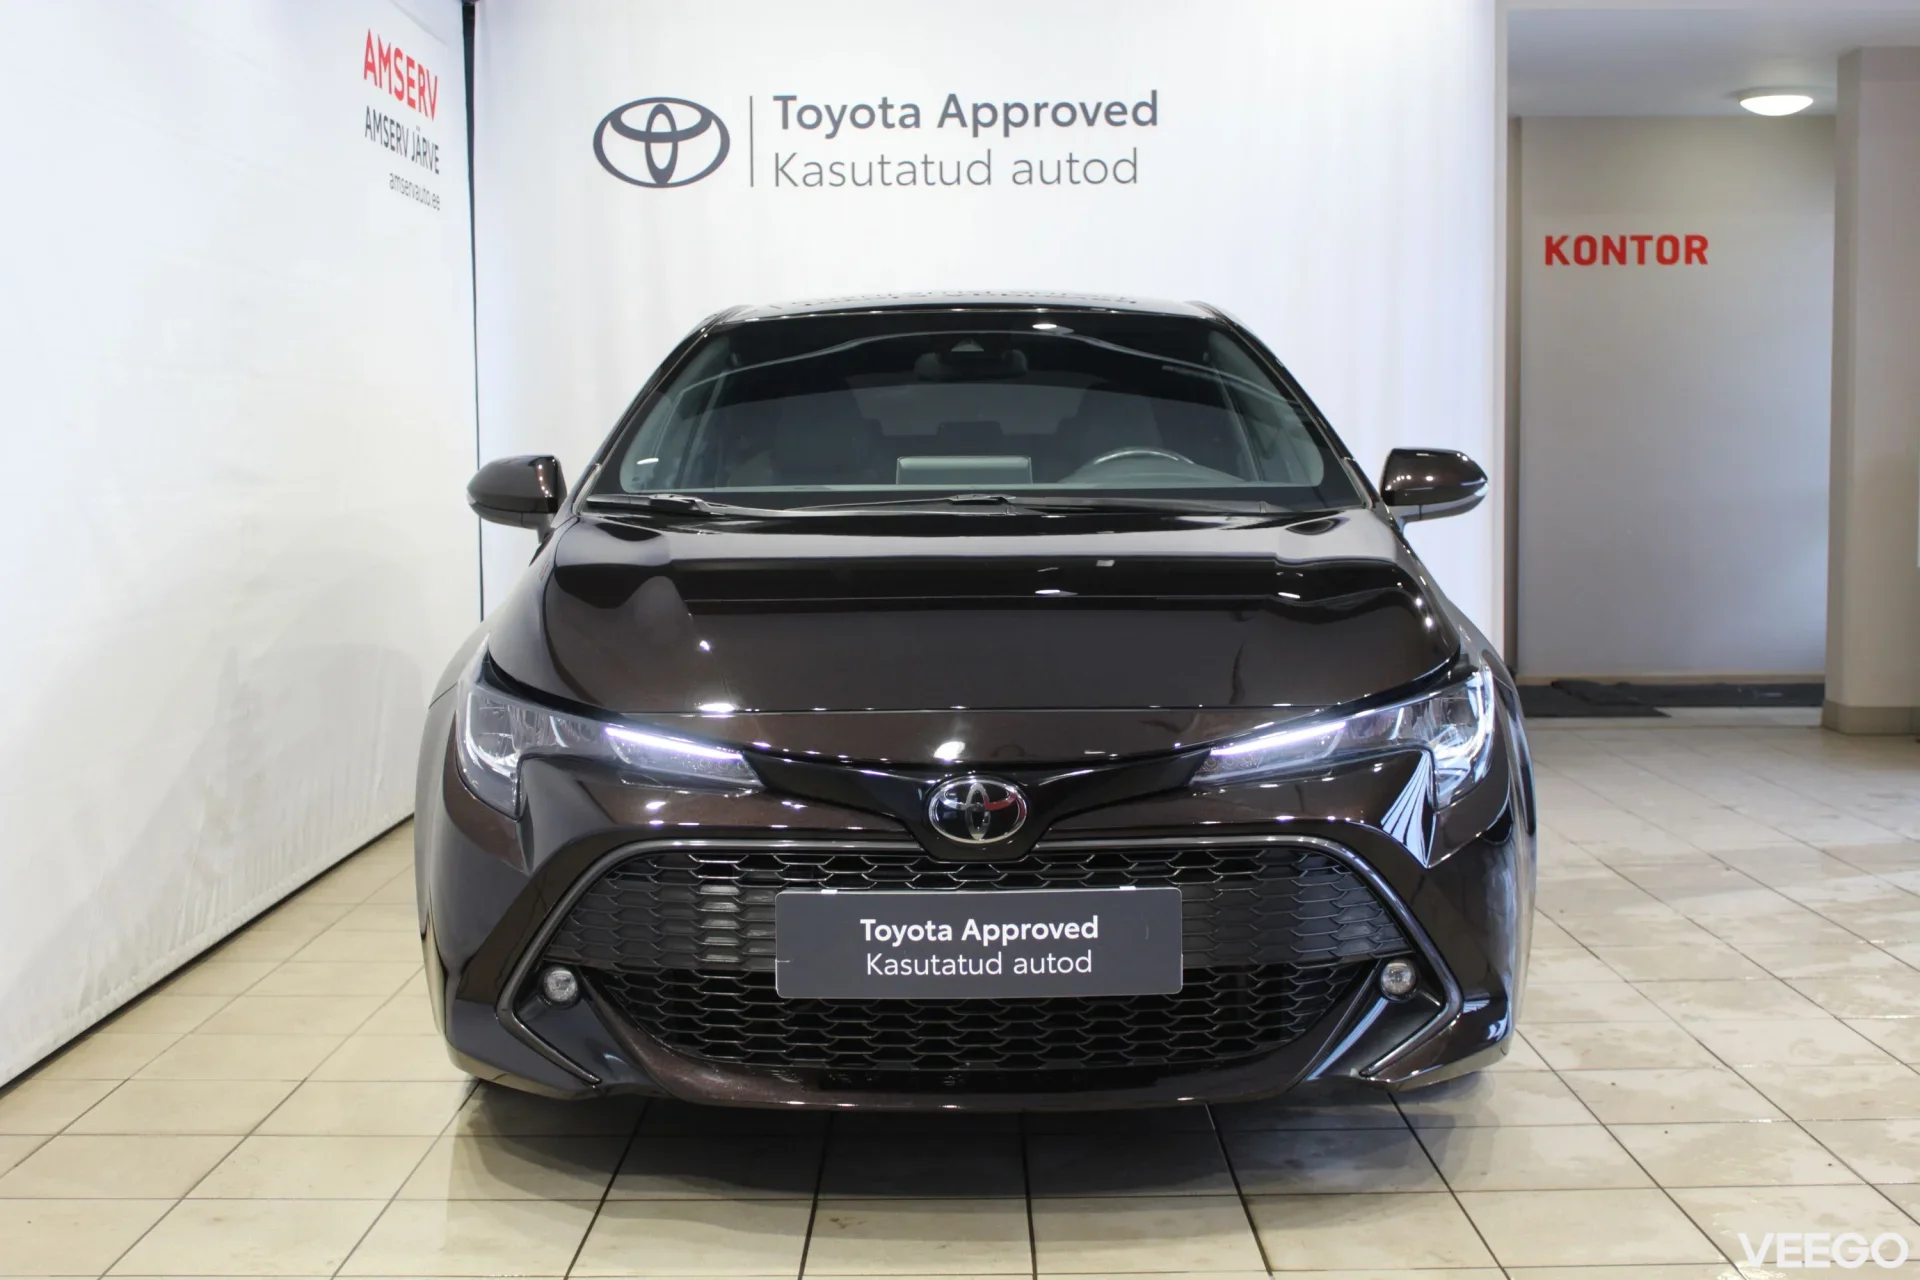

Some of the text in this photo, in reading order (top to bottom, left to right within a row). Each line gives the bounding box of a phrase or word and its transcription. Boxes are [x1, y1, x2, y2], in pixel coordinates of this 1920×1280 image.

[363, 28, 438, 121] AMSERV
[773, 90, 1158, 139] Toyota Approved
[365, 105, 440, 175] AMSERV JÄRVE
[774, 147, 1138, 187] Kasutatud autod
[389, 172, 440, 211] amservauto.ee
[1544, 234, 1709, 266] KONTOR
[860, 915, 1099, 947] Toyota Approved
[866, 949, 1093, 976] Kasutatud autod
